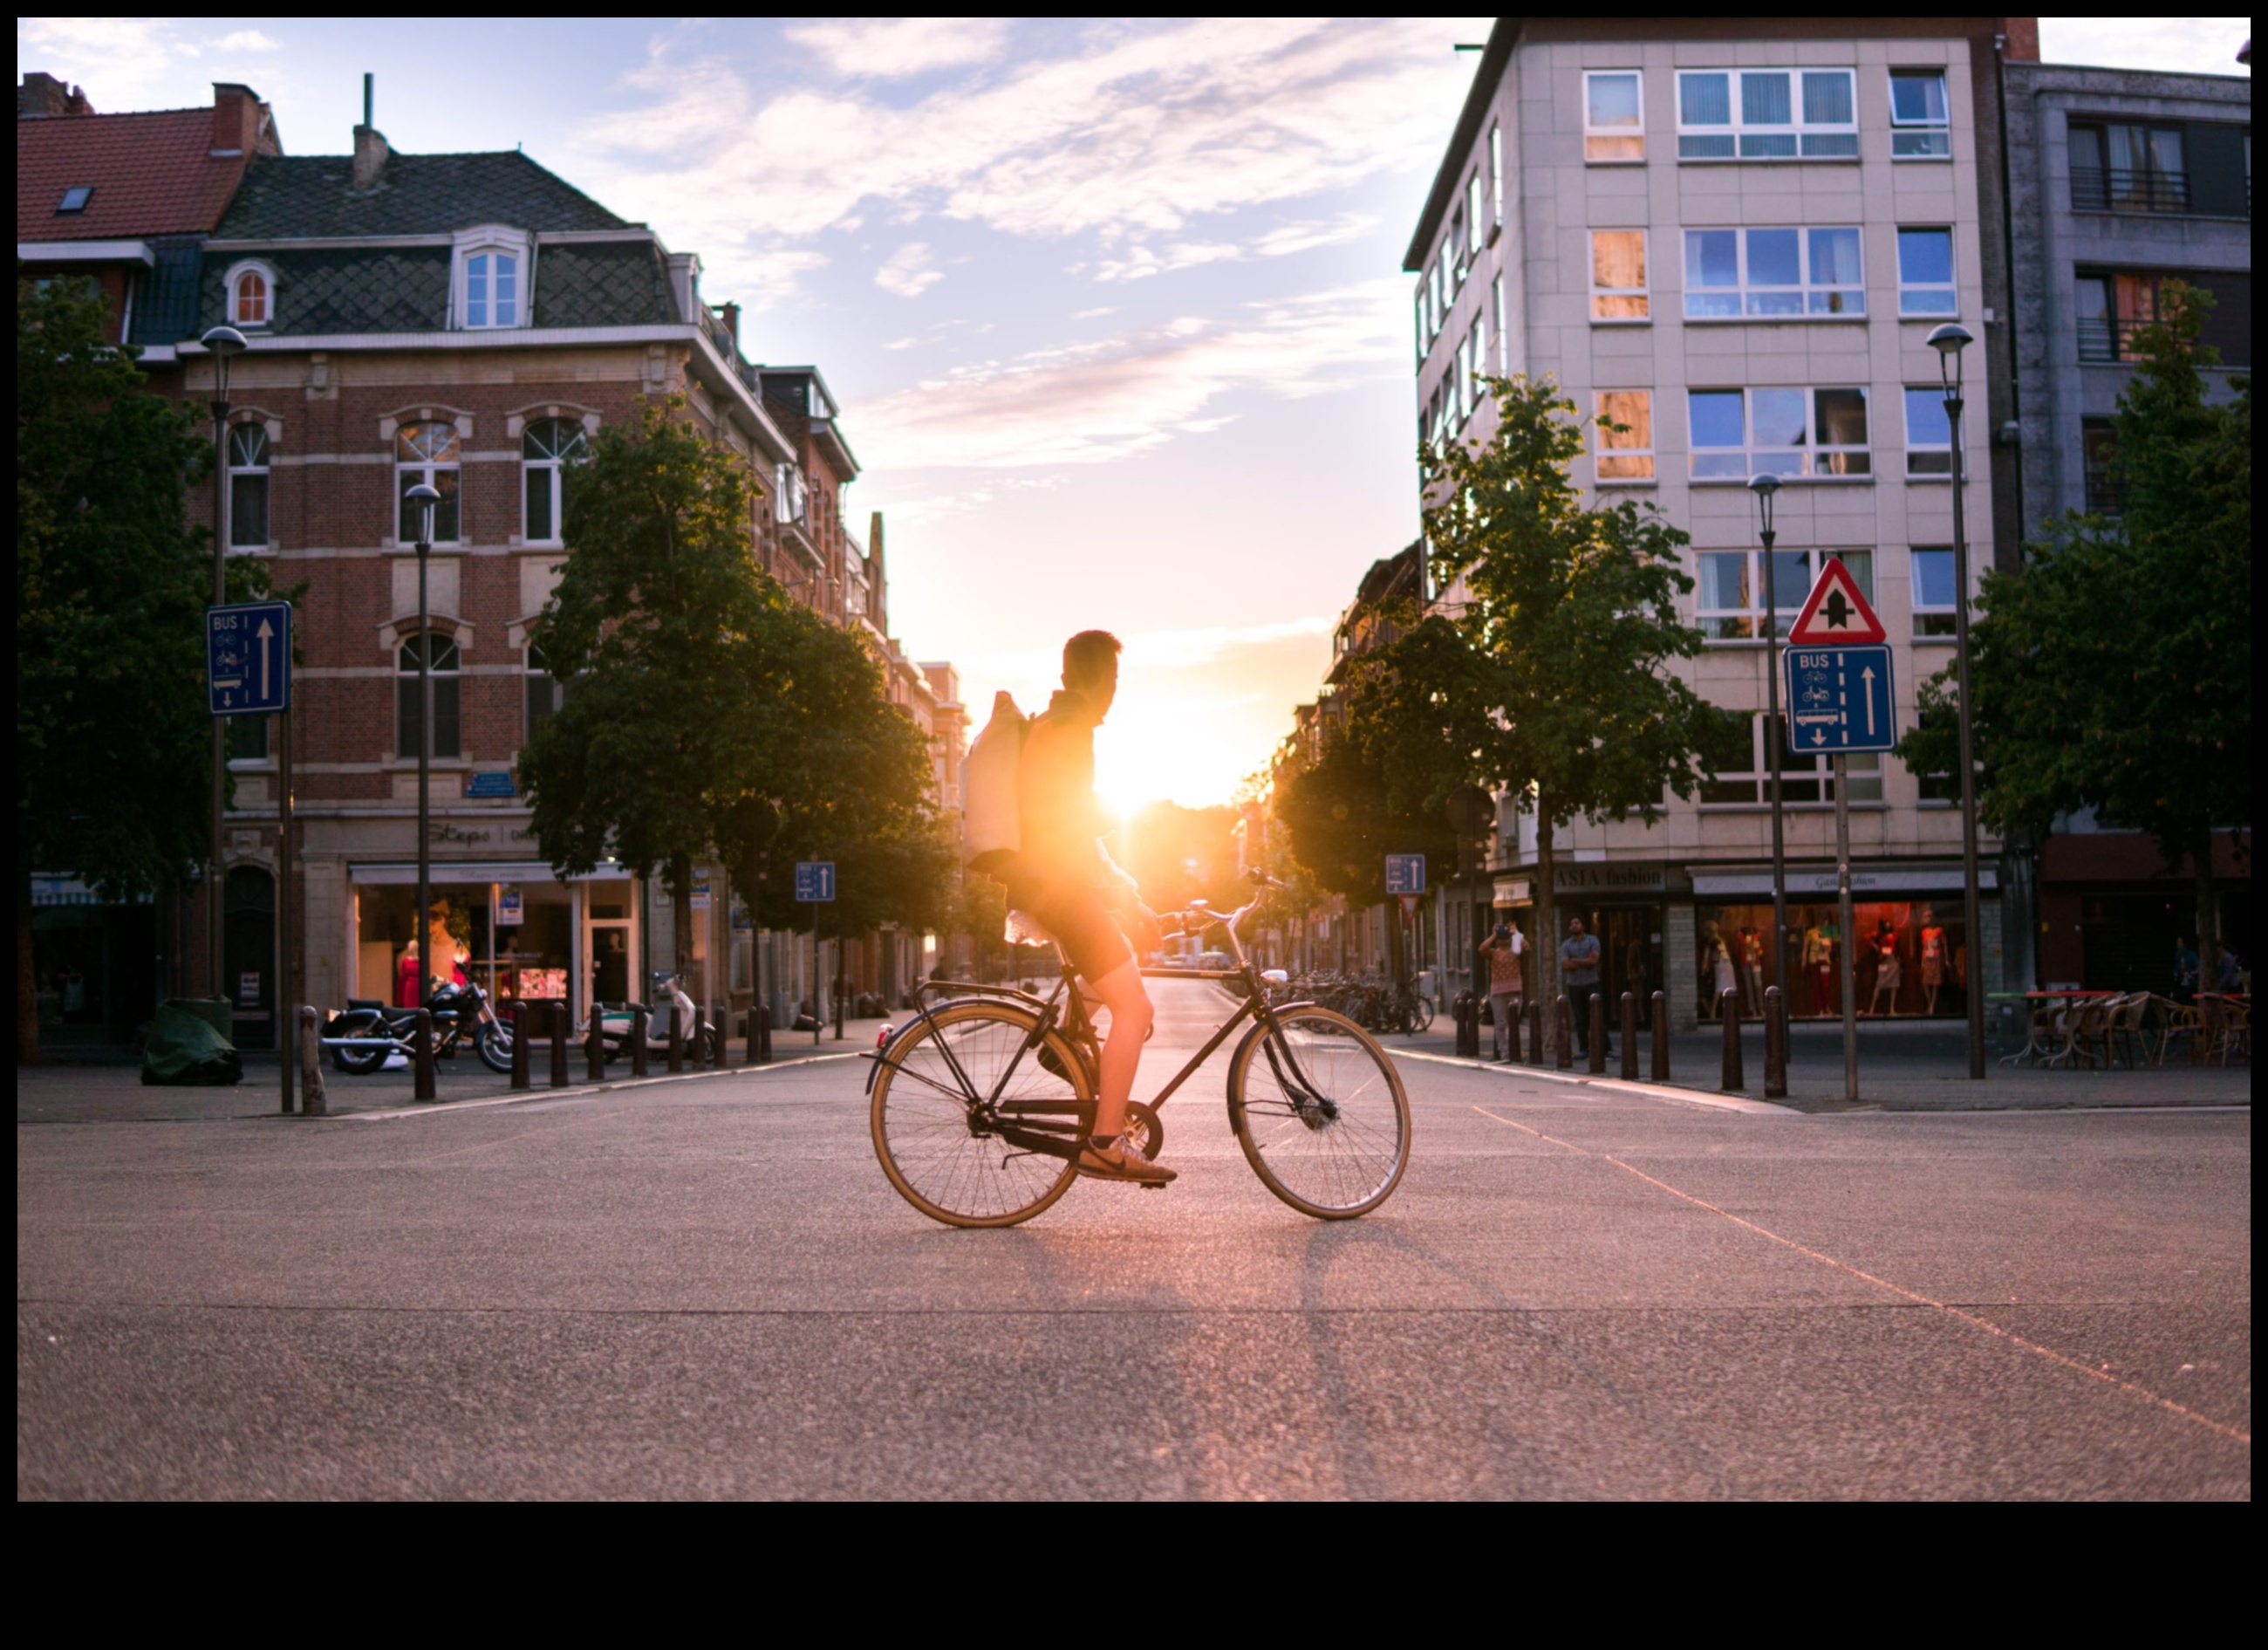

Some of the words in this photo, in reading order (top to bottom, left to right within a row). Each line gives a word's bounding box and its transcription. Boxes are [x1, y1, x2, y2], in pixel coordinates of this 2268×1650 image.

[214, 615, 238, 631] BUS
[1800, 654, 1830, 668] BUS
[427, 824, 490, 847] Steps
[1606, 867, 1662, 885] fashion
